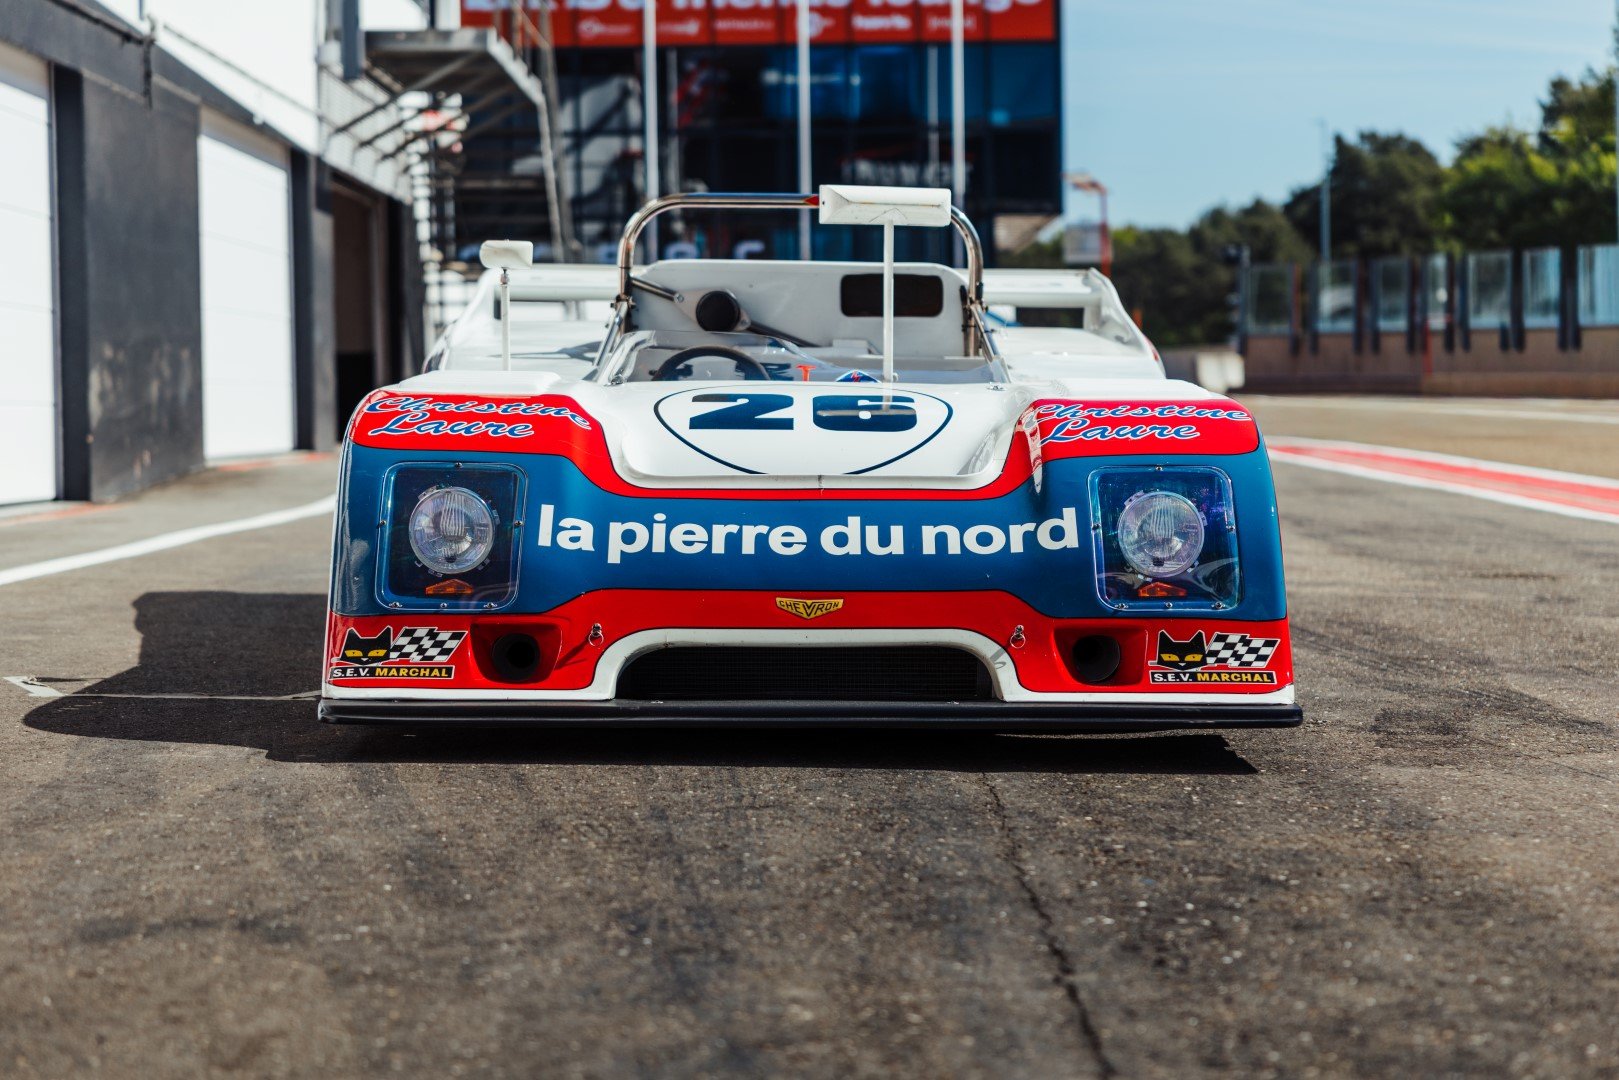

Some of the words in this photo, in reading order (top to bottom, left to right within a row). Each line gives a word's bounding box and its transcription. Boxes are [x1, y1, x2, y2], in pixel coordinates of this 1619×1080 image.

[365, 397, 592, 430] Christine
[367, 411, 535, 439] Laure
[689, 393, 918, 432] 26
[1034, 403, 1252, 421] Christine
[1038, 417, 1201, 448] Laure
[537, 503, 595, 552] la
[607, 512, 808, 564] pierre
[820, 516, 904, 556] du
[921, 507, 1080, 554] nord
[778, 600, 840, 618] CHEVRON
[332, 667, 370, 678] S.E.V.
[374, 667, 449, 677] MARCHAL
[1153, 673, 1193, 682] S.E.V.
[1196, 673, 1272, 683] MARCHAL
